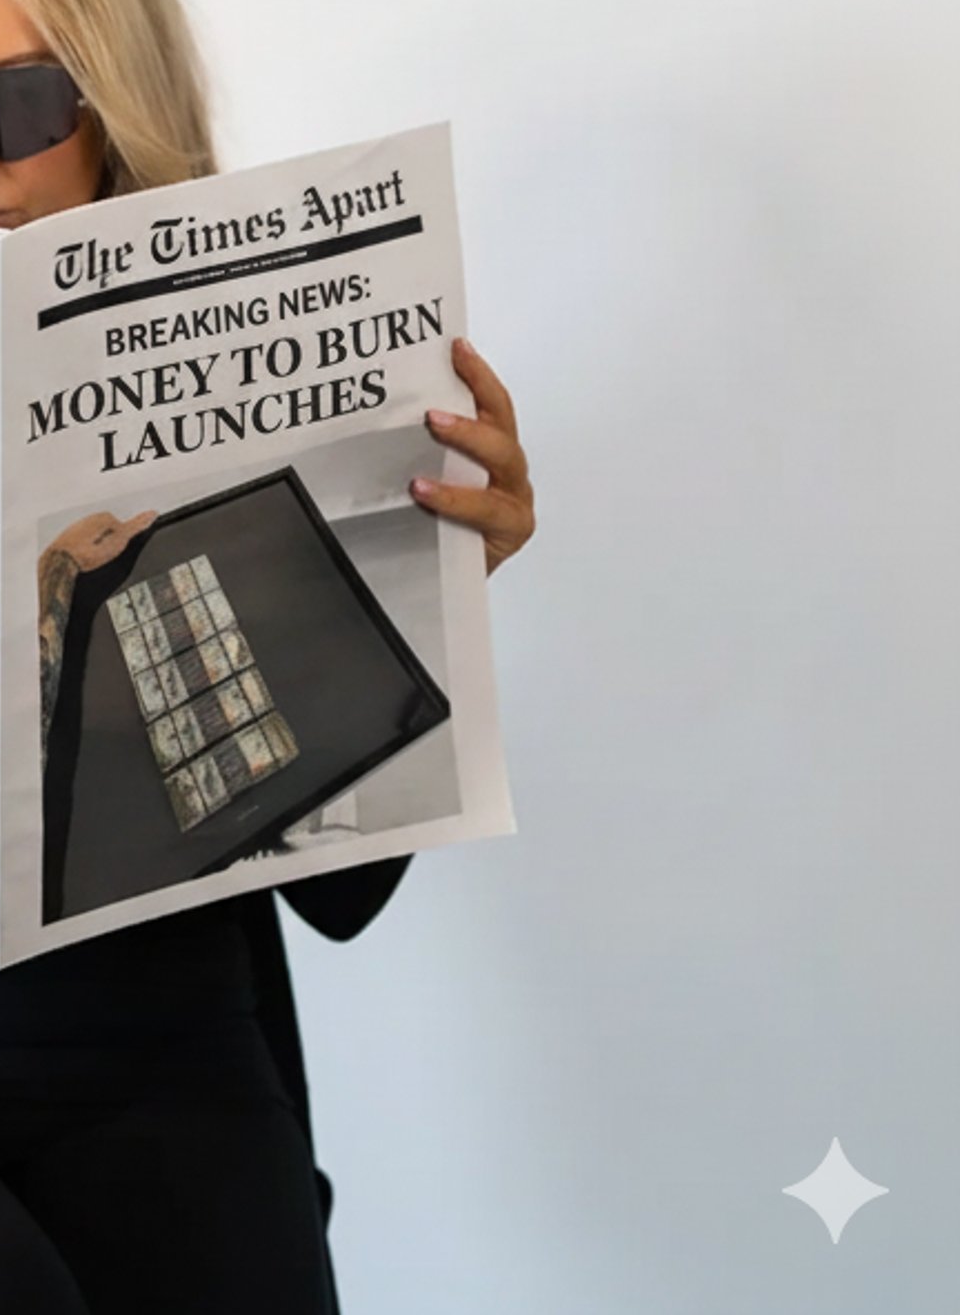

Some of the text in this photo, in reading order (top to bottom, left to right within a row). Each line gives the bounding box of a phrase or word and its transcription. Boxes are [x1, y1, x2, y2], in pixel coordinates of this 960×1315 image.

[54, 237, 134, 289] The
[150, 205, 286, 265] Times
[300, 170, 406, 234] Apart
[26, 297, 445, 445] MONEY TO BURN
[106, 274, 372, 357] BREAKING NEWS:
[98, 369, 387, 472] LAUNCHES
